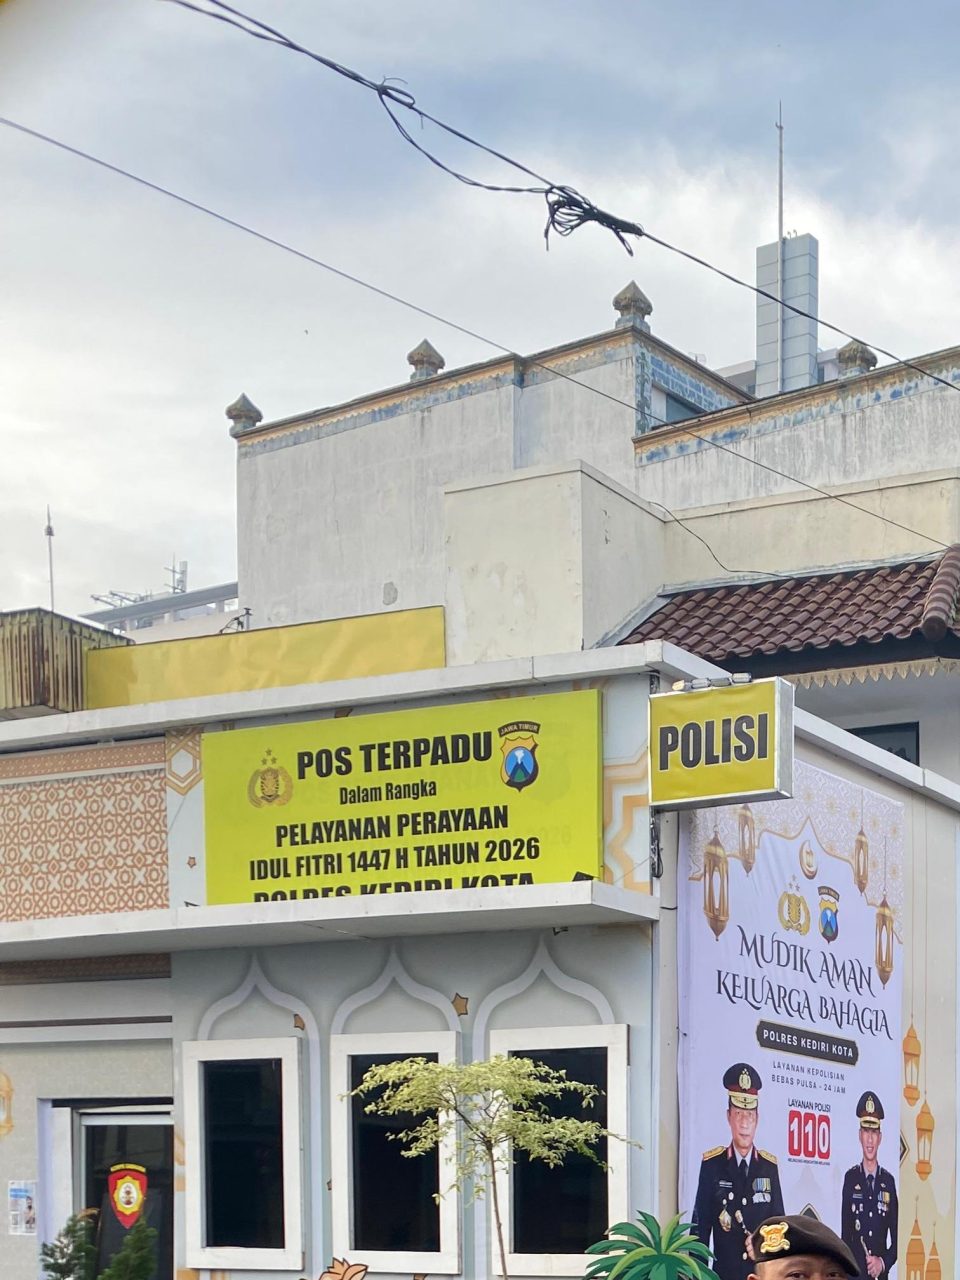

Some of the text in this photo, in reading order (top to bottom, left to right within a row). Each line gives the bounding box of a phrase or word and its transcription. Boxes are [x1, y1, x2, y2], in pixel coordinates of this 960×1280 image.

[500, 724, 518, 735] JAWA
[659, 713, 768, 771] POLISI
[297, 731, 492, 780] POS TERPADU
[339, 779, 437, 805] Dalam Rangka
[276, 805, 509, 847] PELAYANAN PERAYAAN
[250, 836, 540, 880] IDUL FITRI 1447 H TAHUN 2026
[737, 925, 876, 998] MUDIK AMAN
[716, 969, 894, 1040] KELUARGA BAHAGIA
[763, 1029, 853, 1058] POLRES KEDIRI KOTA
[771, 1074, 794, 1085] BEBAS
[796, 1078, 817, 1089] PULSA
[823, 1083, 832, 1092] 24
[833, 1086, 846, 1094] JAM
[772, 1060, 845, 1081] LAYANAN KEPOLISIAN
[788, 1097, 831, 1113] LAYANAN POLISI
[789, 1115, 830, 1155] 110
